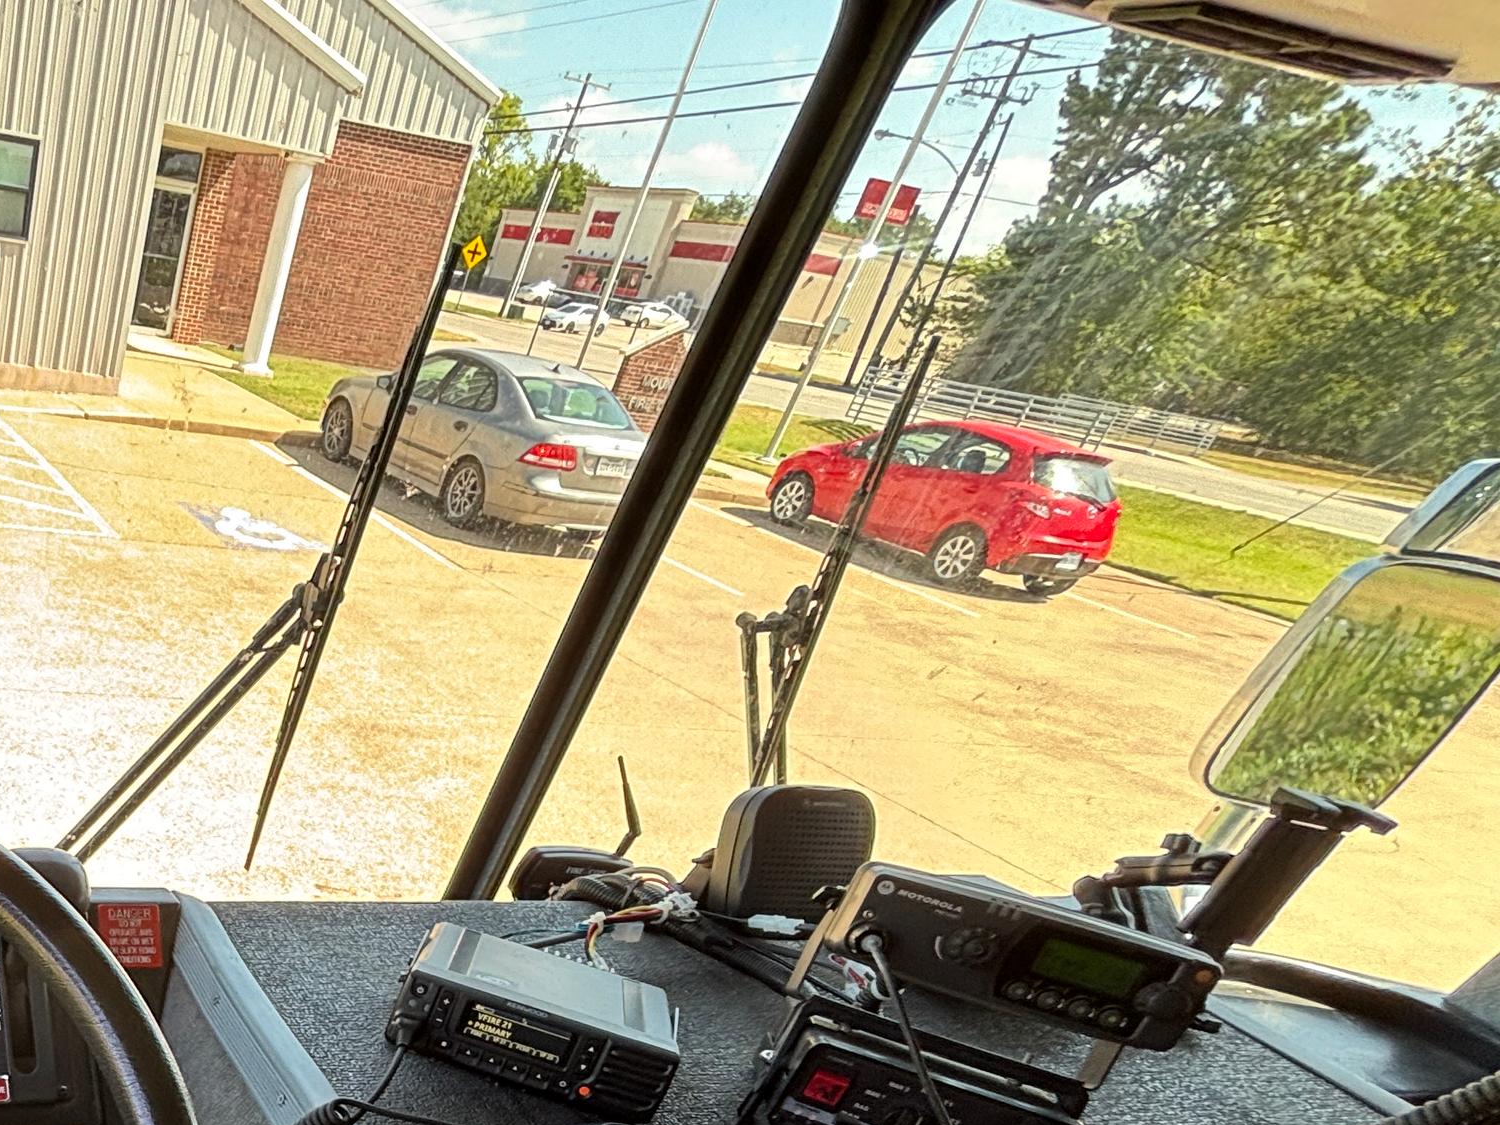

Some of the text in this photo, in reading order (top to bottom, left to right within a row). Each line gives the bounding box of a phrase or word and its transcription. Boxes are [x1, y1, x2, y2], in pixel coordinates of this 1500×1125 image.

[898, 889, 963, 913] MOTOROLA
[108, 908, 151, 919] DANGER
[506, 1001, 549, 1018] KENWOOD
[473, 1021, 512, 1039] PRIMARY
[501, 1020, 512, 1030] 21
